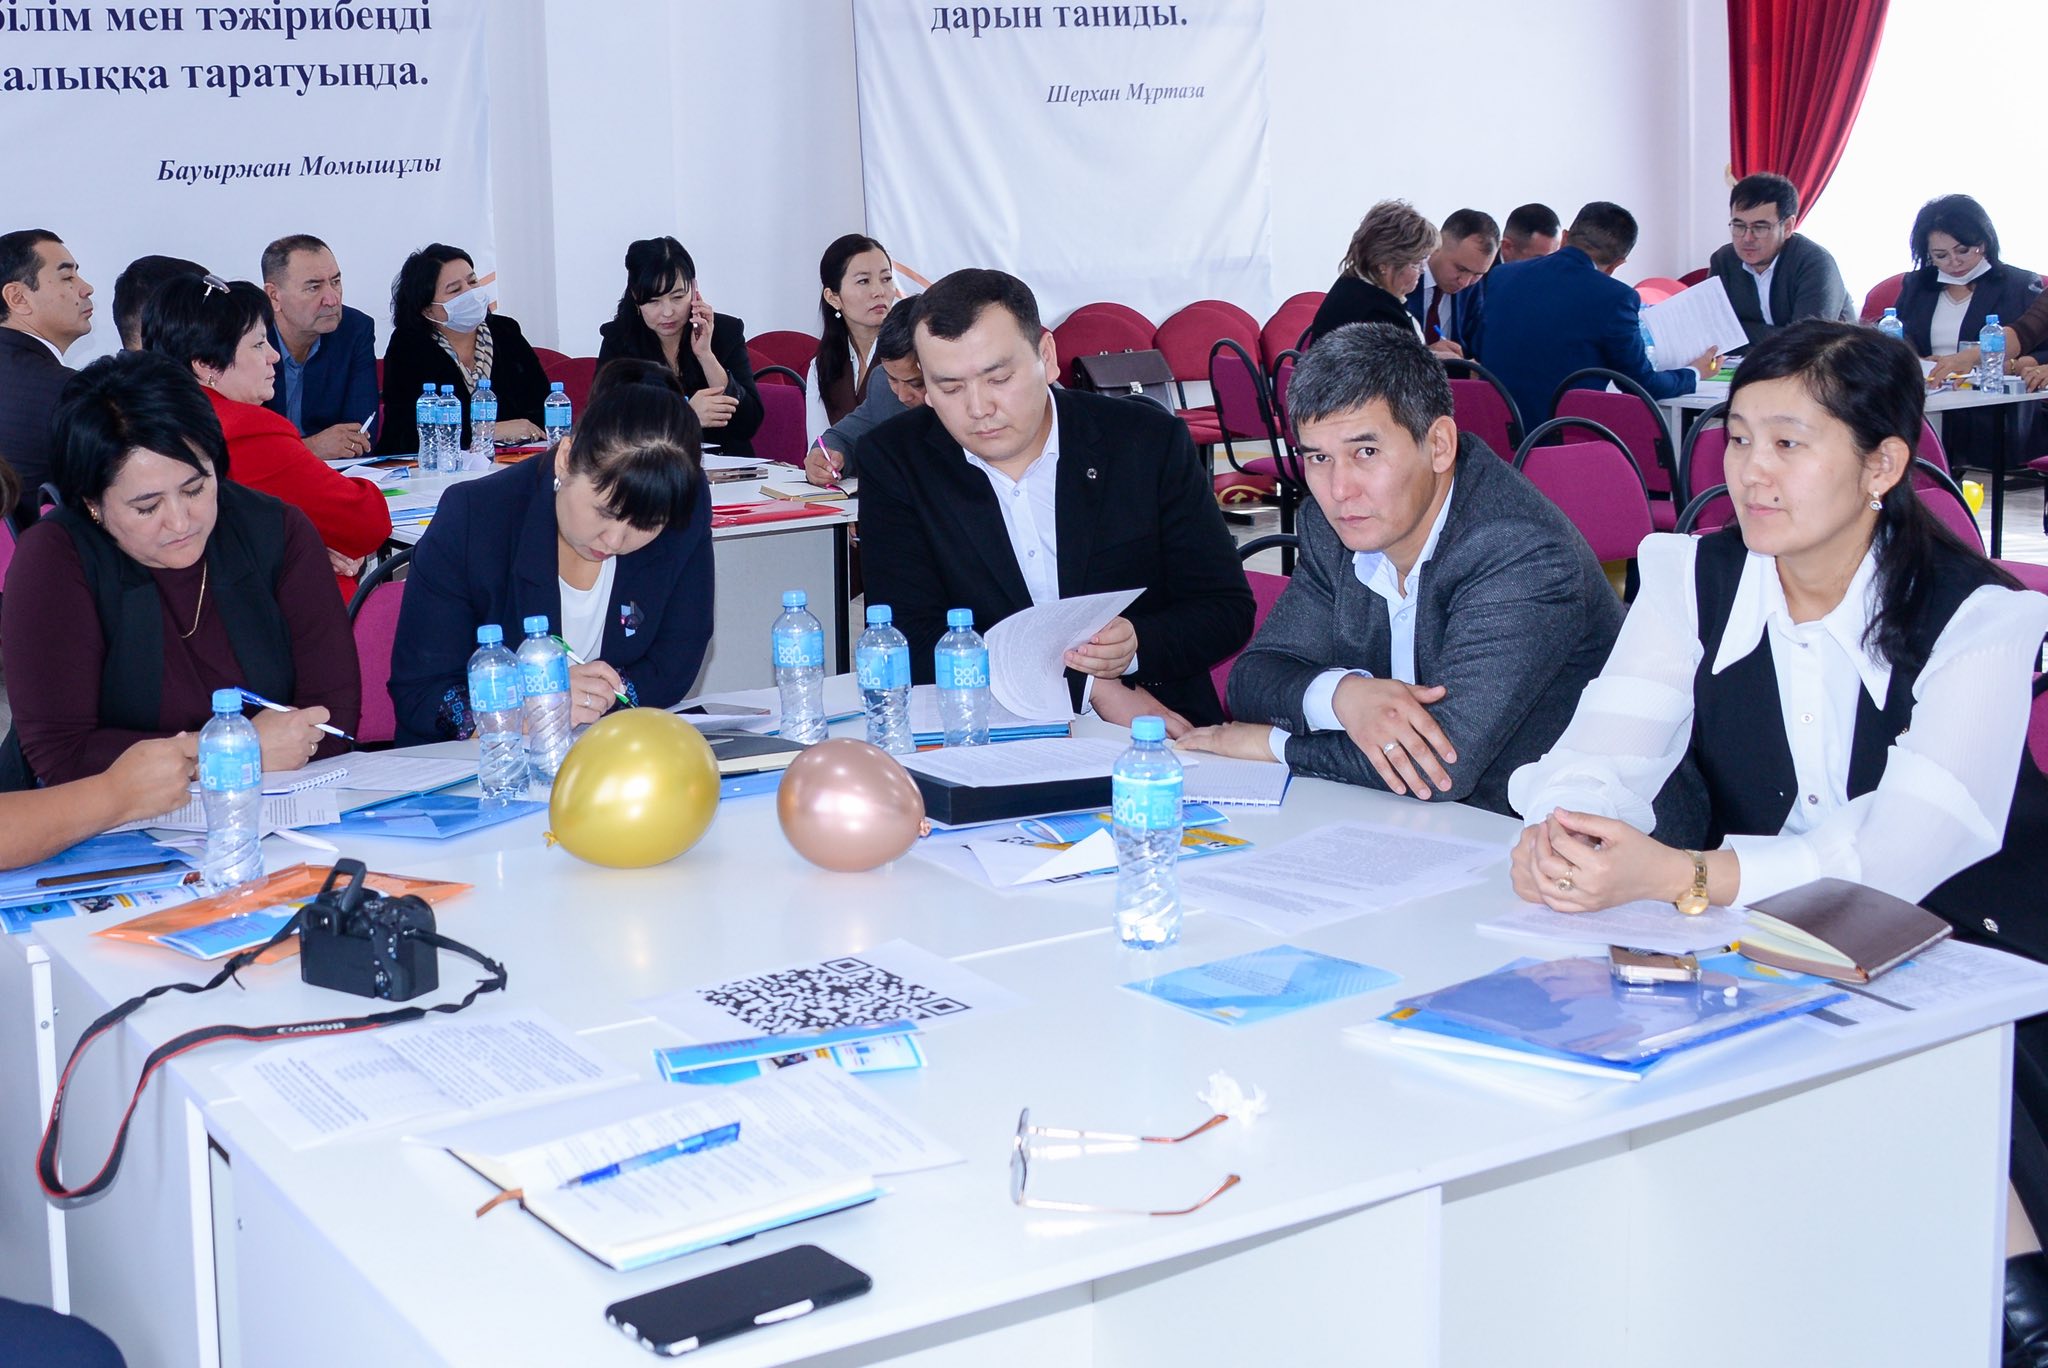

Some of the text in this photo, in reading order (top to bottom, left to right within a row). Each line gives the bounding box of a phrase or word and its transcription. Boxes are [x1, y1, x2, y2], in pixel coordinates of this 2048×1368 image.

[0, 0, 432, 40] ілім мен тәжірибеңді
[931, 4, 1188, 38] дарын таниды.
[0, 62, 429, 97] алыққа таратуыңда.
[1047, 83, 1205, 107] Шерхан Мұртаза
[157, 155, 442, 186] Бауыржан Момышұлы
